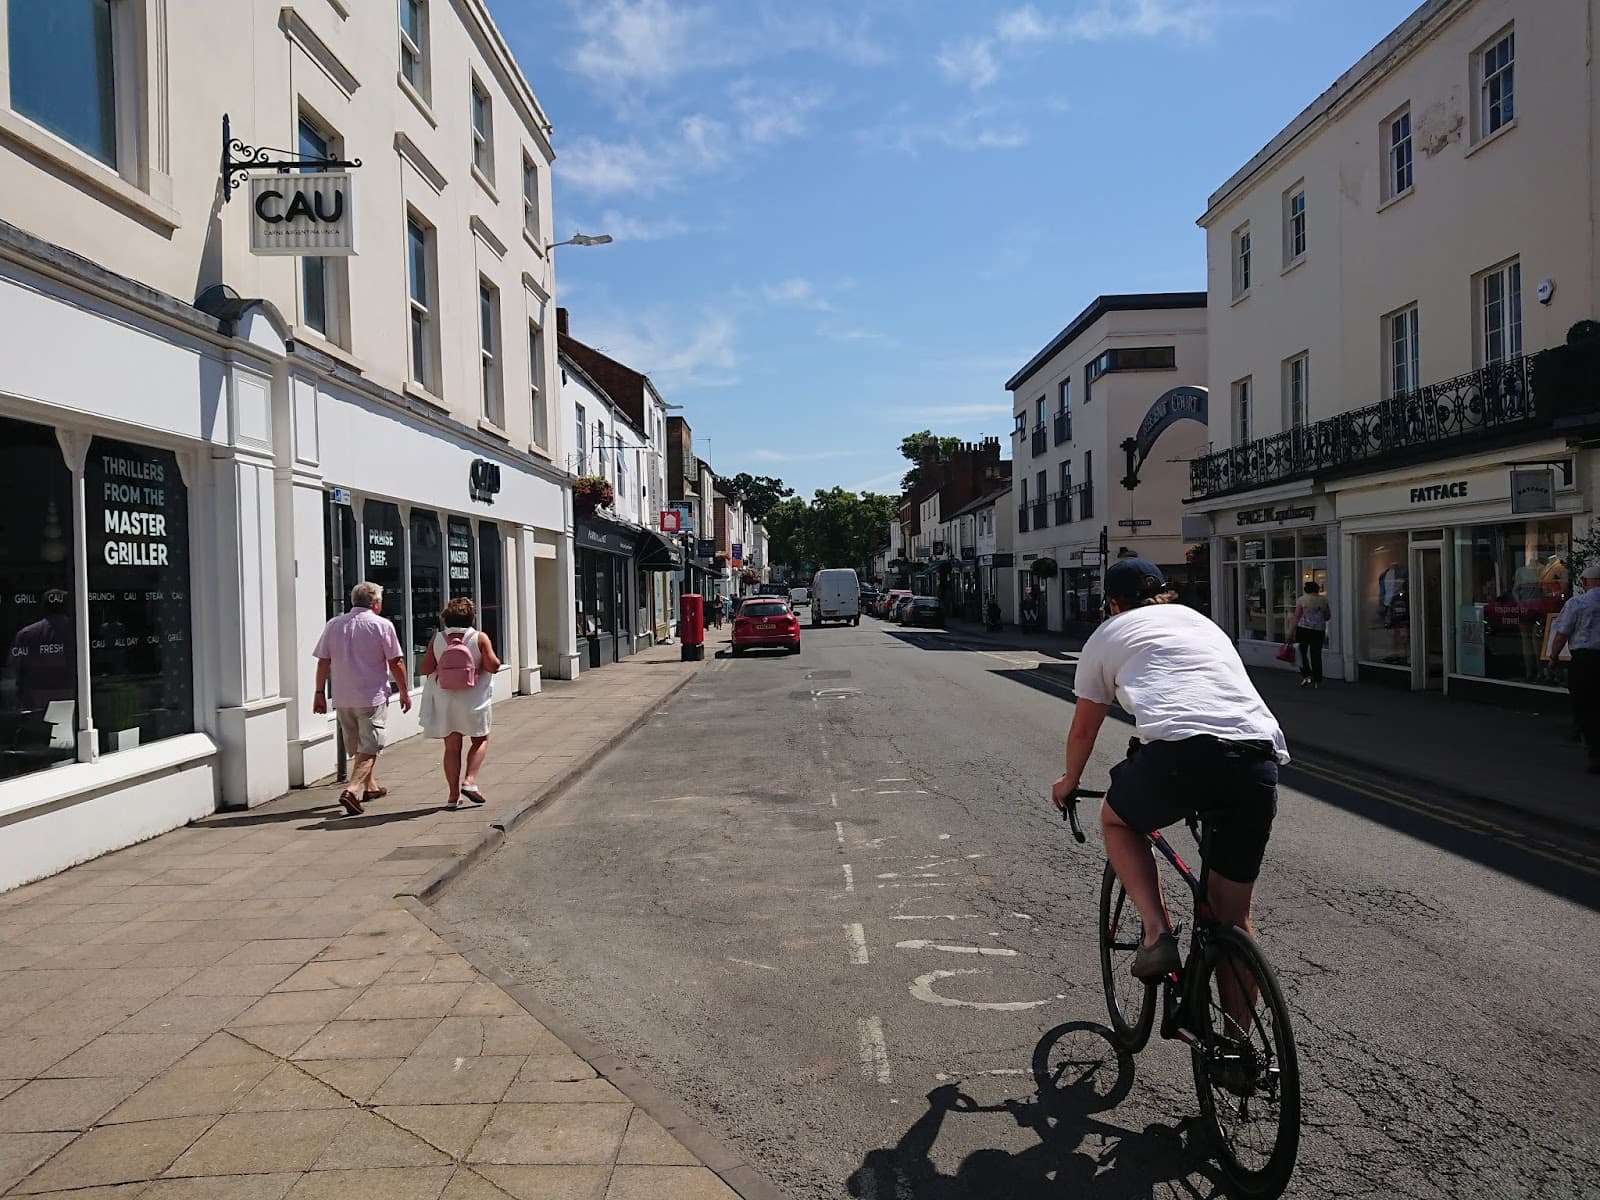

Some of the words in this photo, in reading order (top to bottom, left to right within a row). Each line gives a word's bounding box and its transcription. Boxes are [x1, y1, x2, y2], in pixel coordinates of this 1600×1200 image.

[255, 190, 344, 224] CAU
[102, 456, 165, 482] THRILLERS
[103, 483, 141, 504] FROM
[143, 489, 165, 506] THE
[1410, 481, 1468, 503] FATFACE
[104, 509, 167, 537] MASTER
[369, 528, 394, 547] PRAISE
[104, 541, 169, 566] GRILLER
[14, 593, 37, 604] GRILL
[48, 593, 64, 604] CAU
[88, 592, 115, 602] BRUNCH
[124, 592, 137, 601] CAU
[145, 592, 164, 601] STEAK
[11, 646, 29, 657] CAU
[39, 643, 65, 655] FRESH
[91, 639, 106, 649] CAU
[114, 638, 125, 647] ALL
[147, 635, 160, 644] CAU
